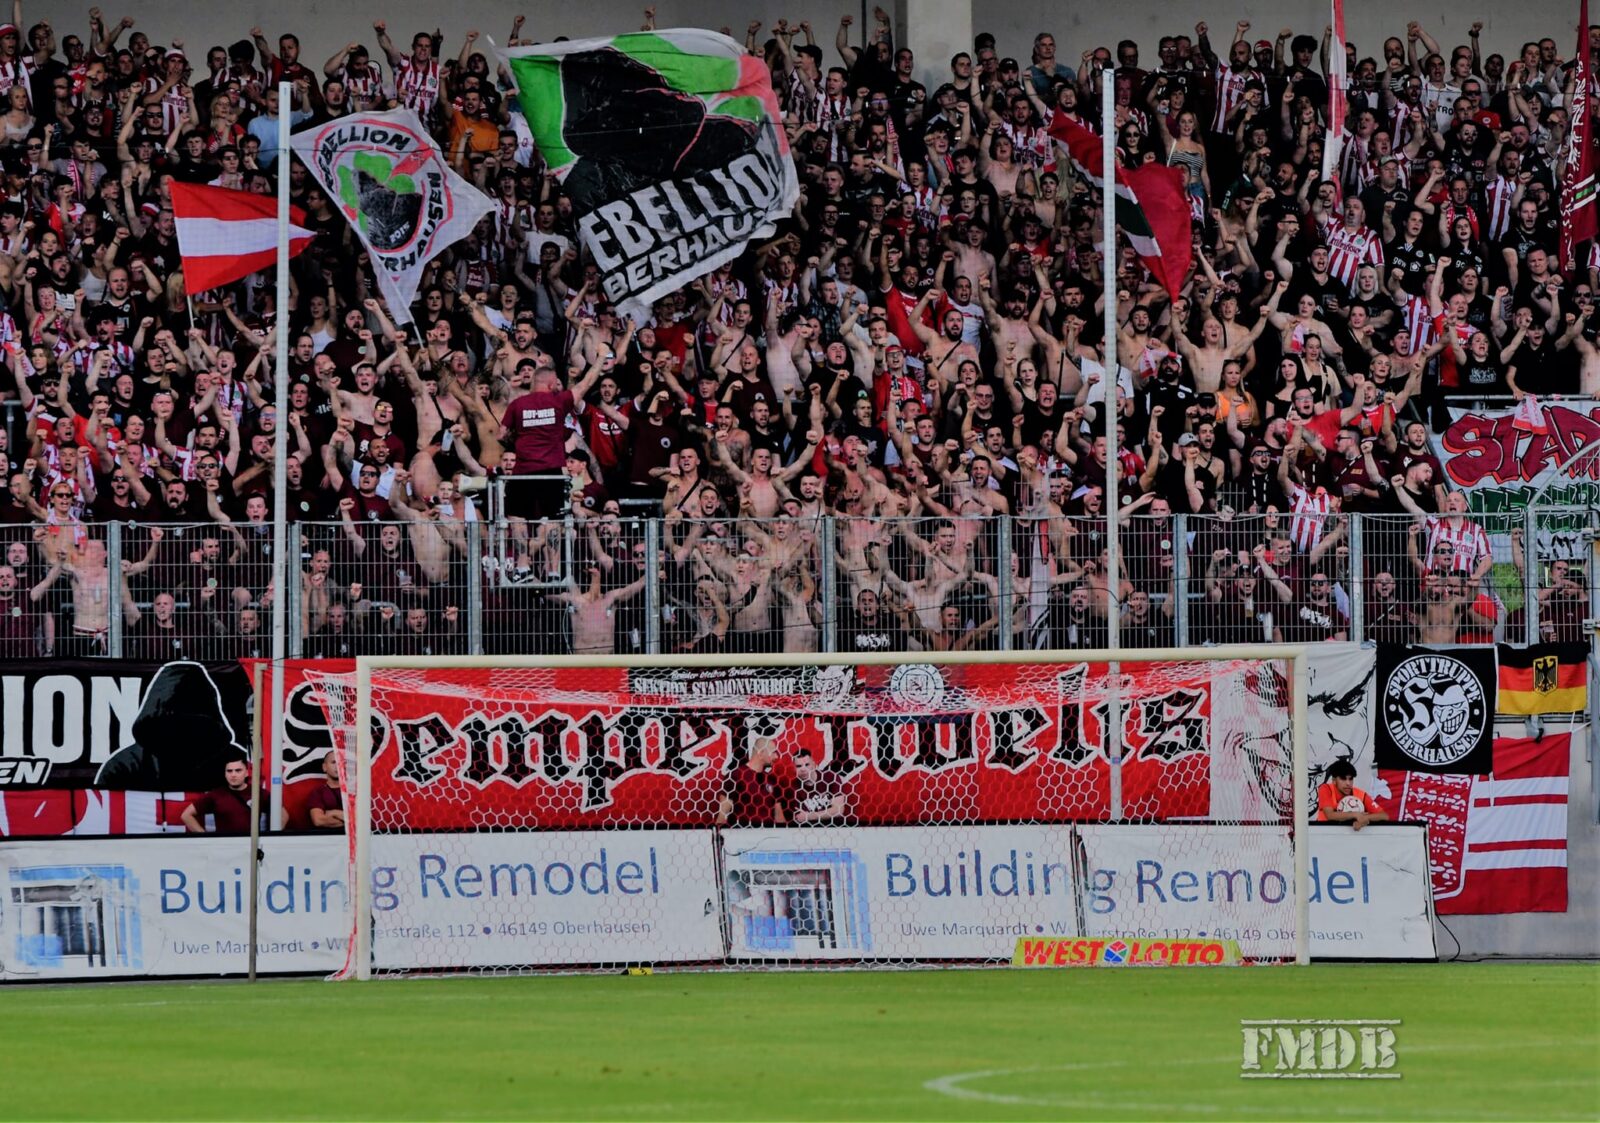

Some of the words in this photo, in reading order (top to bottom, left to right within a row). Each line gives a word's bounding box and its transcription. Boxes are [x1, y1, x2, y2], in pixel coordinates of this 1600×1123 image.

[579, 153, 781, 273] EBELLIO
[602, 210, 768, 303] BERHAU
[1442, 405, 1600, 487] STAD
[692, 678, 796, 697] STADIONVERBOT
[1389, 657, 1481, 703] SPORTTRUPPE
[282, 680, 787, 811] Semper
[1390, 720, 1480, 763] OBERHAUSEN
[160, 866, 399, 911] Buiding
[419, 847, 659, 899] Remodel
[886, 850, 1116, 914] Building
[174, 941, 210, 954] Uwe
[448, 924, 477, 938] 112
[498, 922, 547, 937] 46149
[553, 920, 651, 935] Oberhausen
[901, 923, 936, 936] Uwe
[943, 922, 1029, 938] Marquardt
[1213, 928, 1262, 941] 46149
[1266, 928, 1364, 941] Obehausen
[1023, 940, 1105, 966] WEST
[1128, 942, 1225, 966] LOTTO
